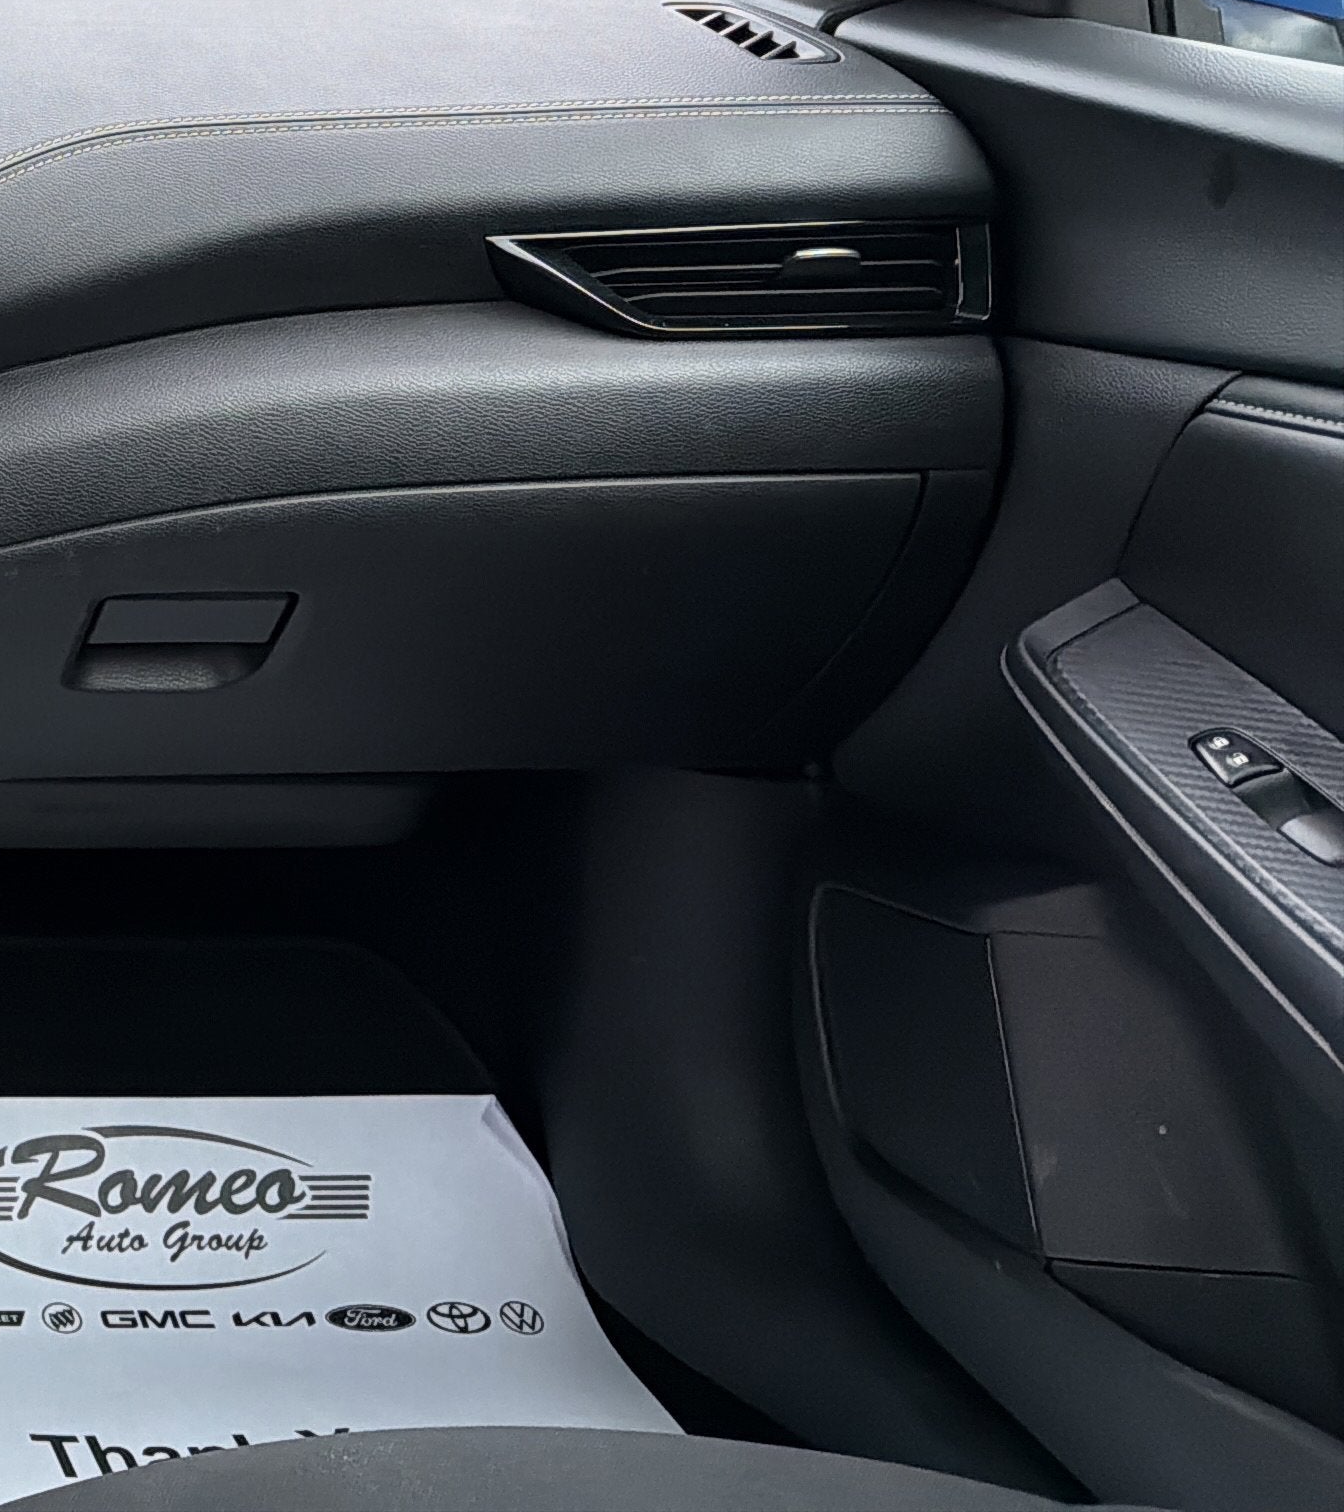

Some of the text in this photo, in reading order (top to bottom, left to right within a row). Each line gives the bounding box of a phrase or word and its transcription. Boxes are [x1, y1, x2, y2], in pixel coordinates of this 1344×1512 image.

[10, 1134, 307, 1220] Romeo
[61, 1220, 270, 1263] Auto Group
[100, 1309, 217, 1330] GMC
[341, 1306, 400, 1329] Ford
